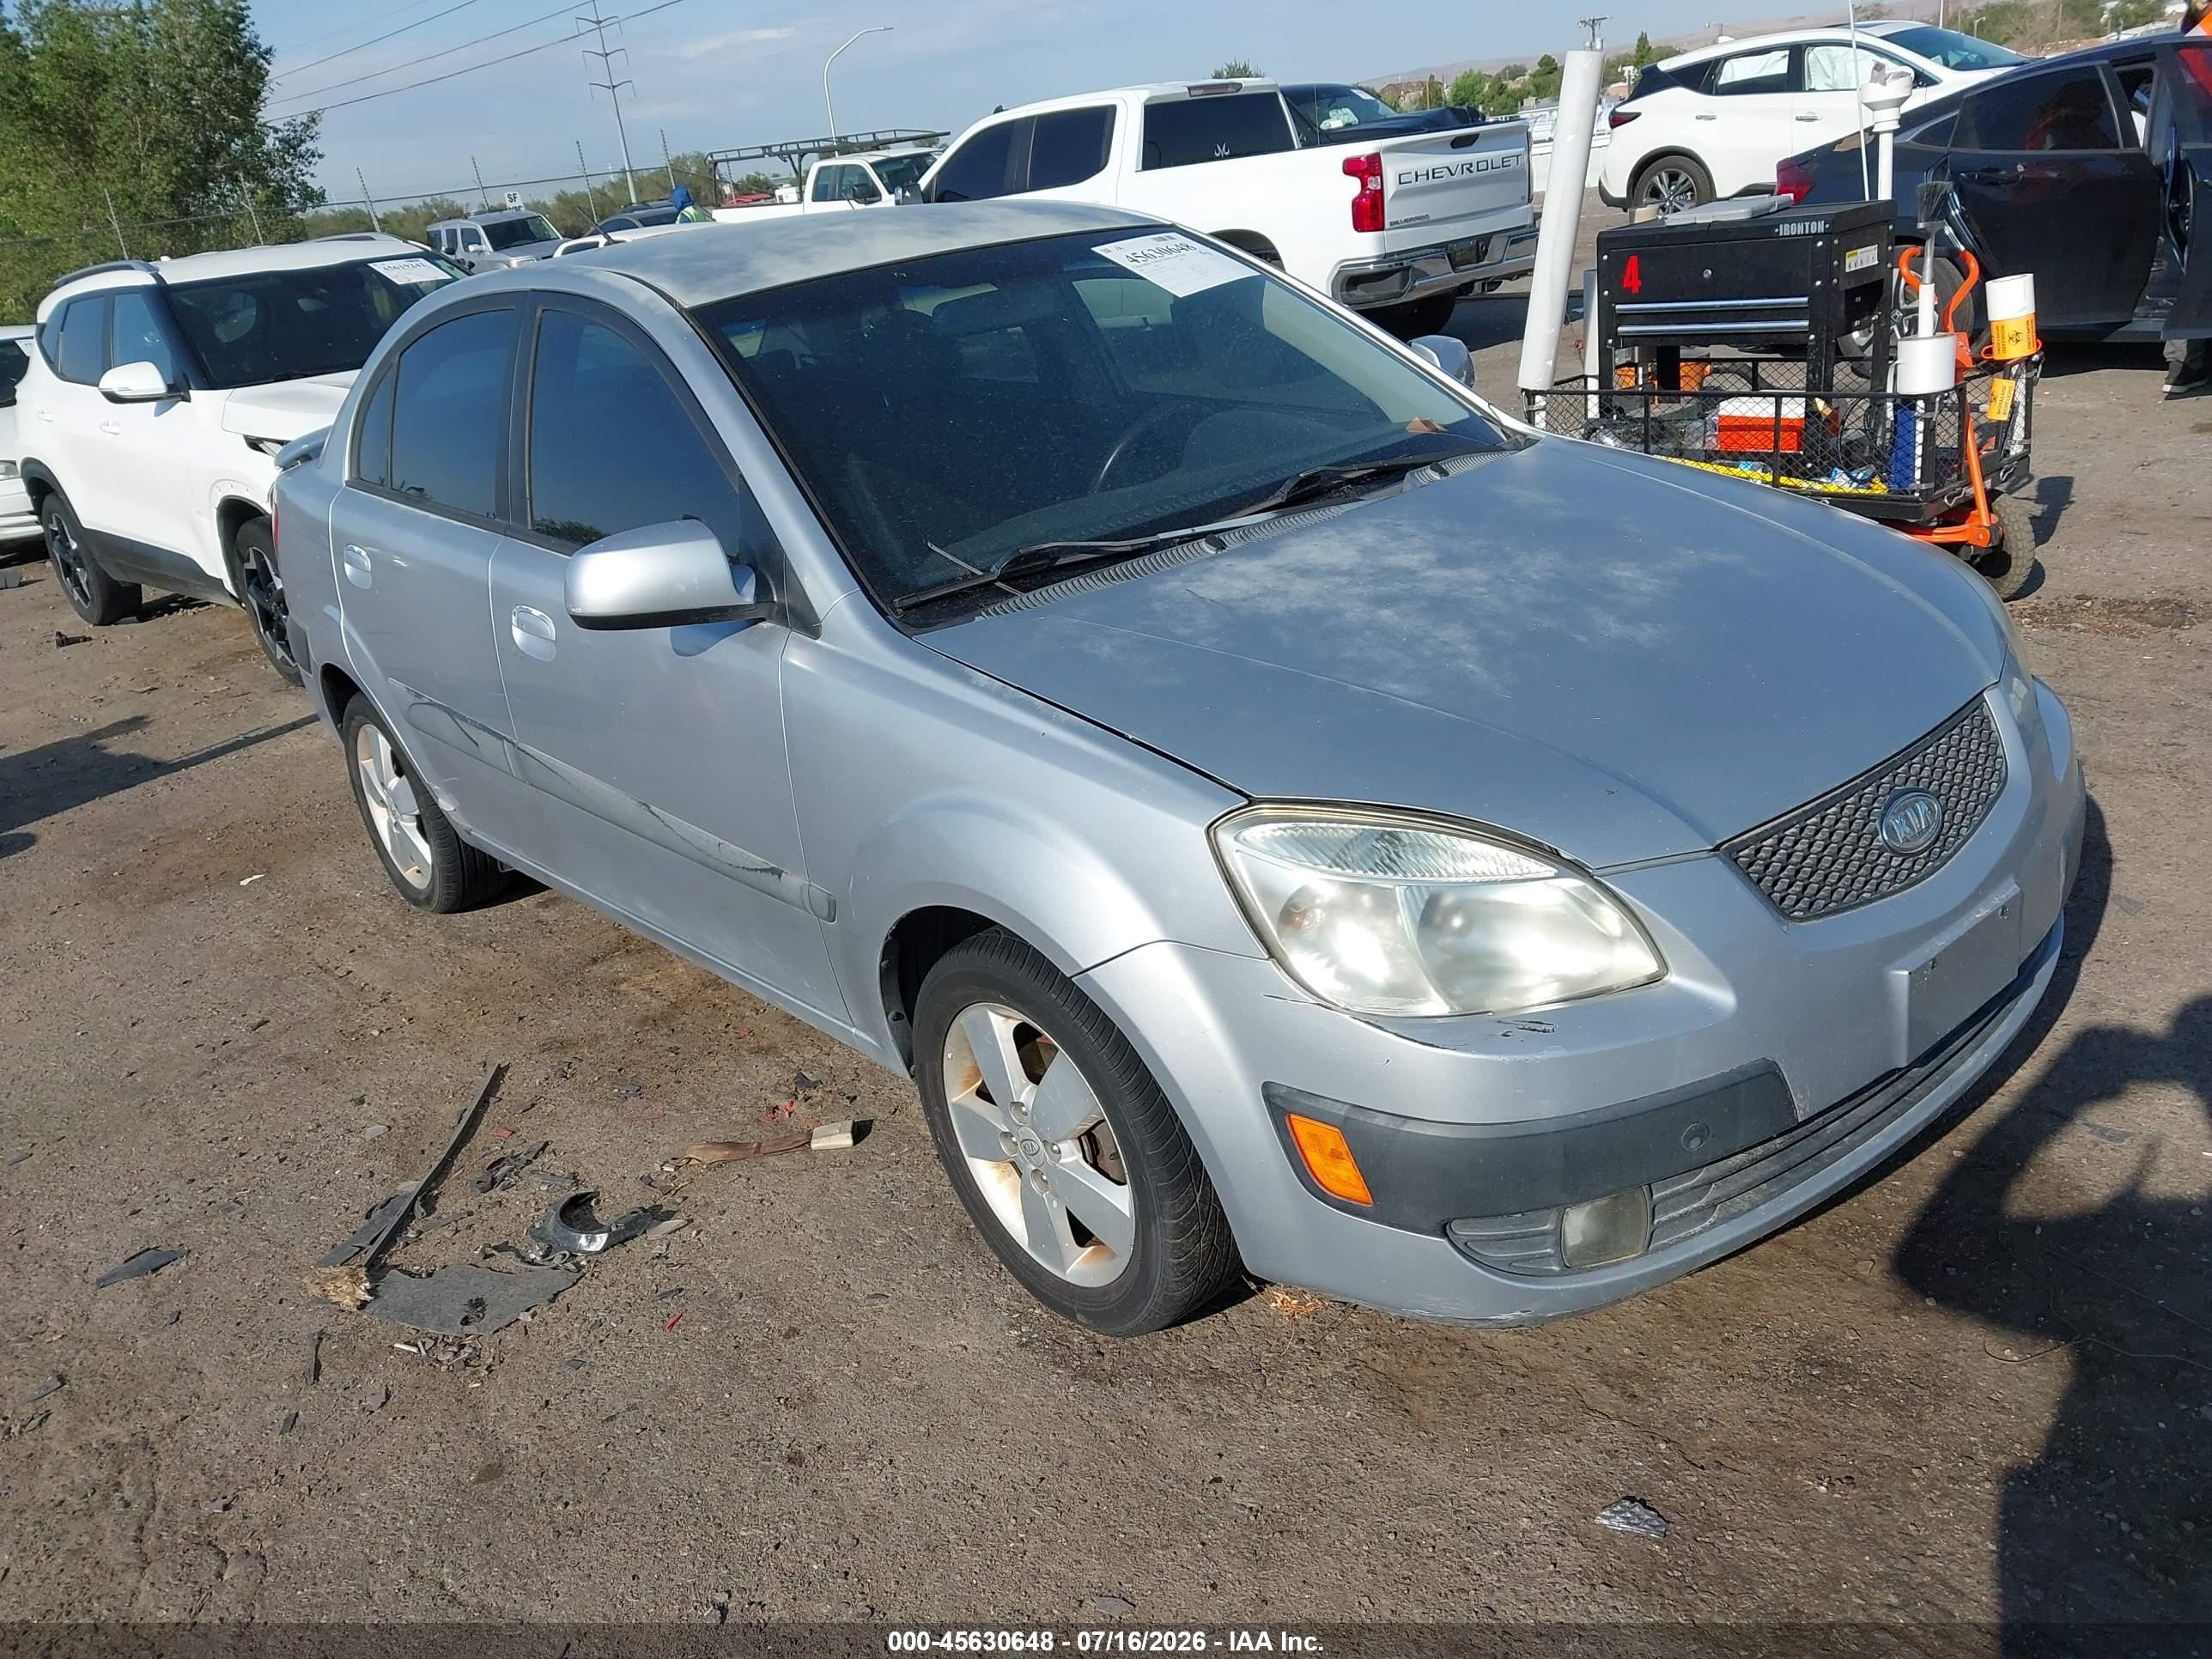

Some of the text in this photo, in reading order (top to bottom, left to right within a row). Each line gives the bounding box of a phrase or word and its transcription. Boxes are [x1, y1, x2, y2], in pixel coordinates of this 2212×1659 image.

[1398, 153, 1522, 185] CHEVROLET
[507, 192, 518, 204] SF
[1778, 220, 1825, 236] IRONTON
[1125, 241, 1197, 265] 45630648
[1622, 255, 1642, 295] 4
[1889, 800, 1932, 843] KIA
[1022, 1141, 1038, 1153] KIA
